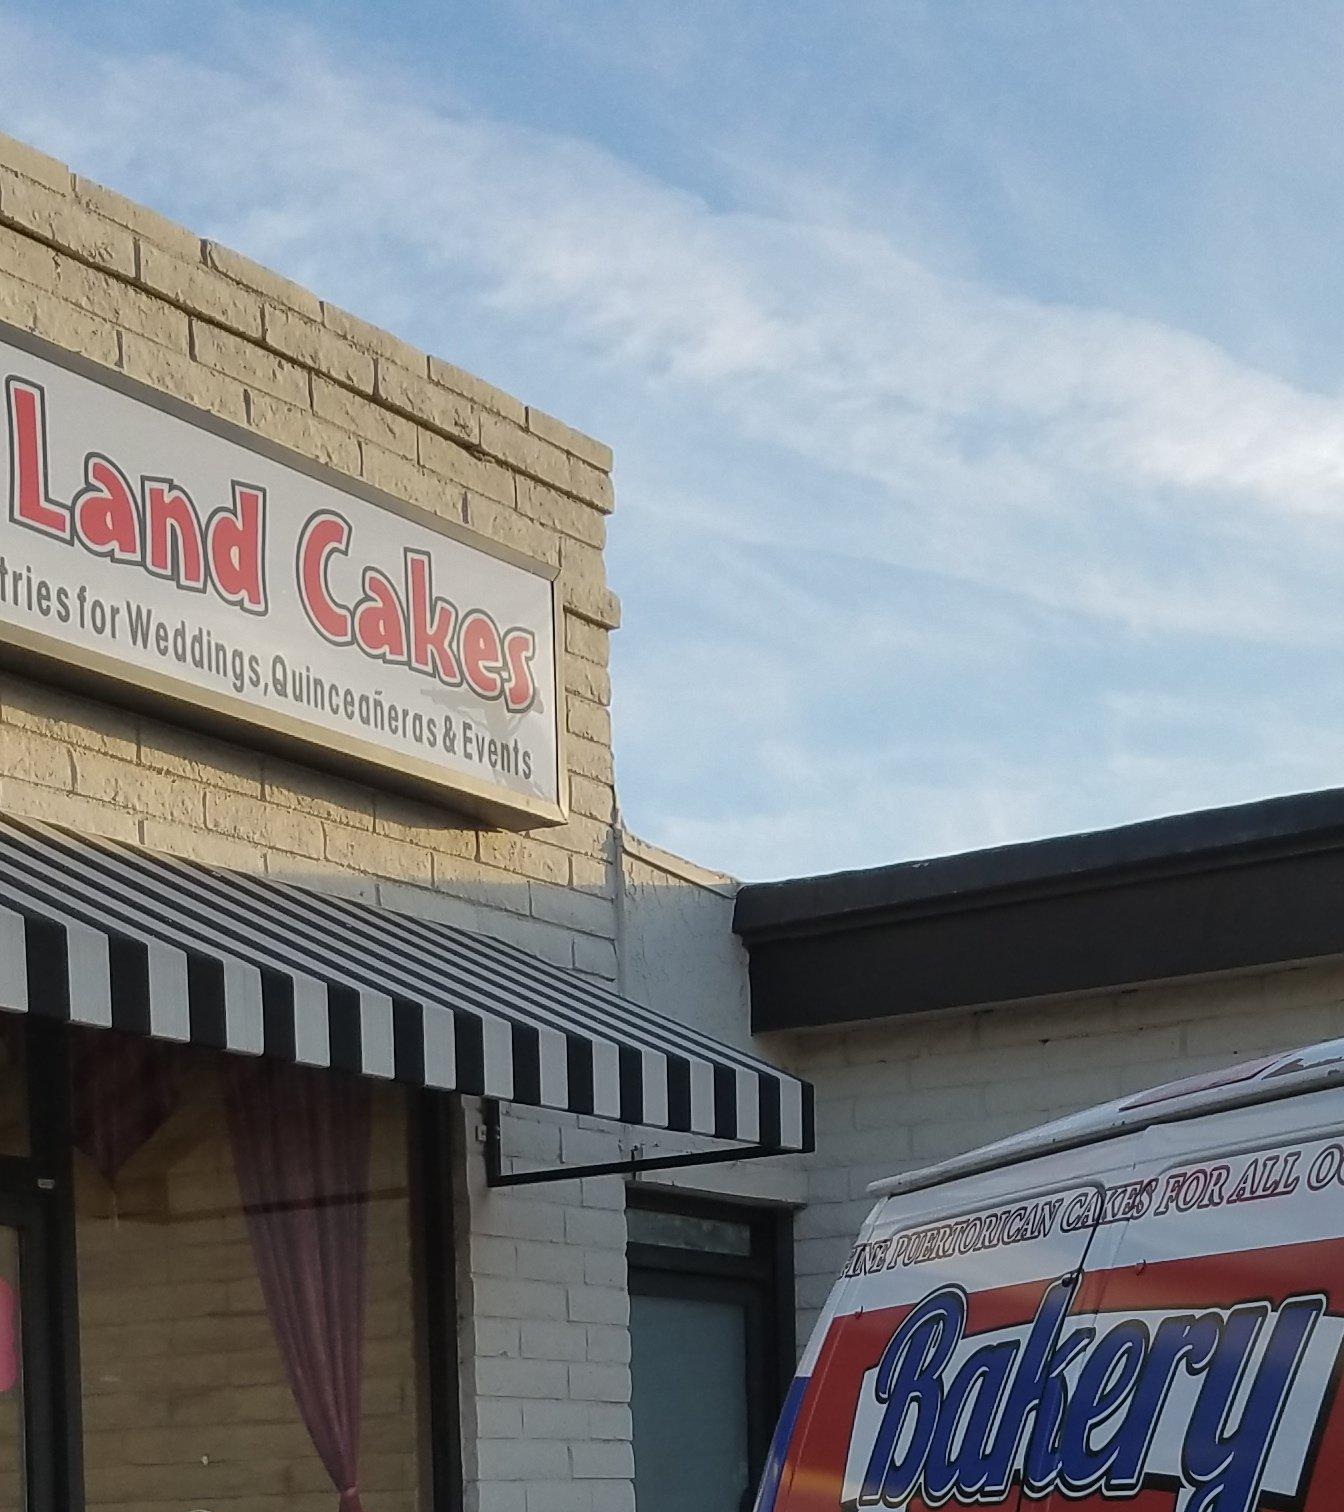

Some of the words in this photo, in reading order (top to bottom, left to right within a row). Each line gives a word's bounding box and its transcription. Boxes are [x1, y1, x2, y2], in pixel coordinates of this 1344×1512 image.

[5, 375, 269, 616] Land
[296, 509, 537, 714] Cakes
[77, 591, 119, 639] for
[443, 715, 456, 755] &
[463, 723, 532, 780] Events
[887, 1199, 1063, 1270] PUERTORICAN
[1059, 1178, 1156, 1233] CAKES
[1155, 1162, 1232, 1217] FOR
[1226, 1150, 1302, 1206] ALL
